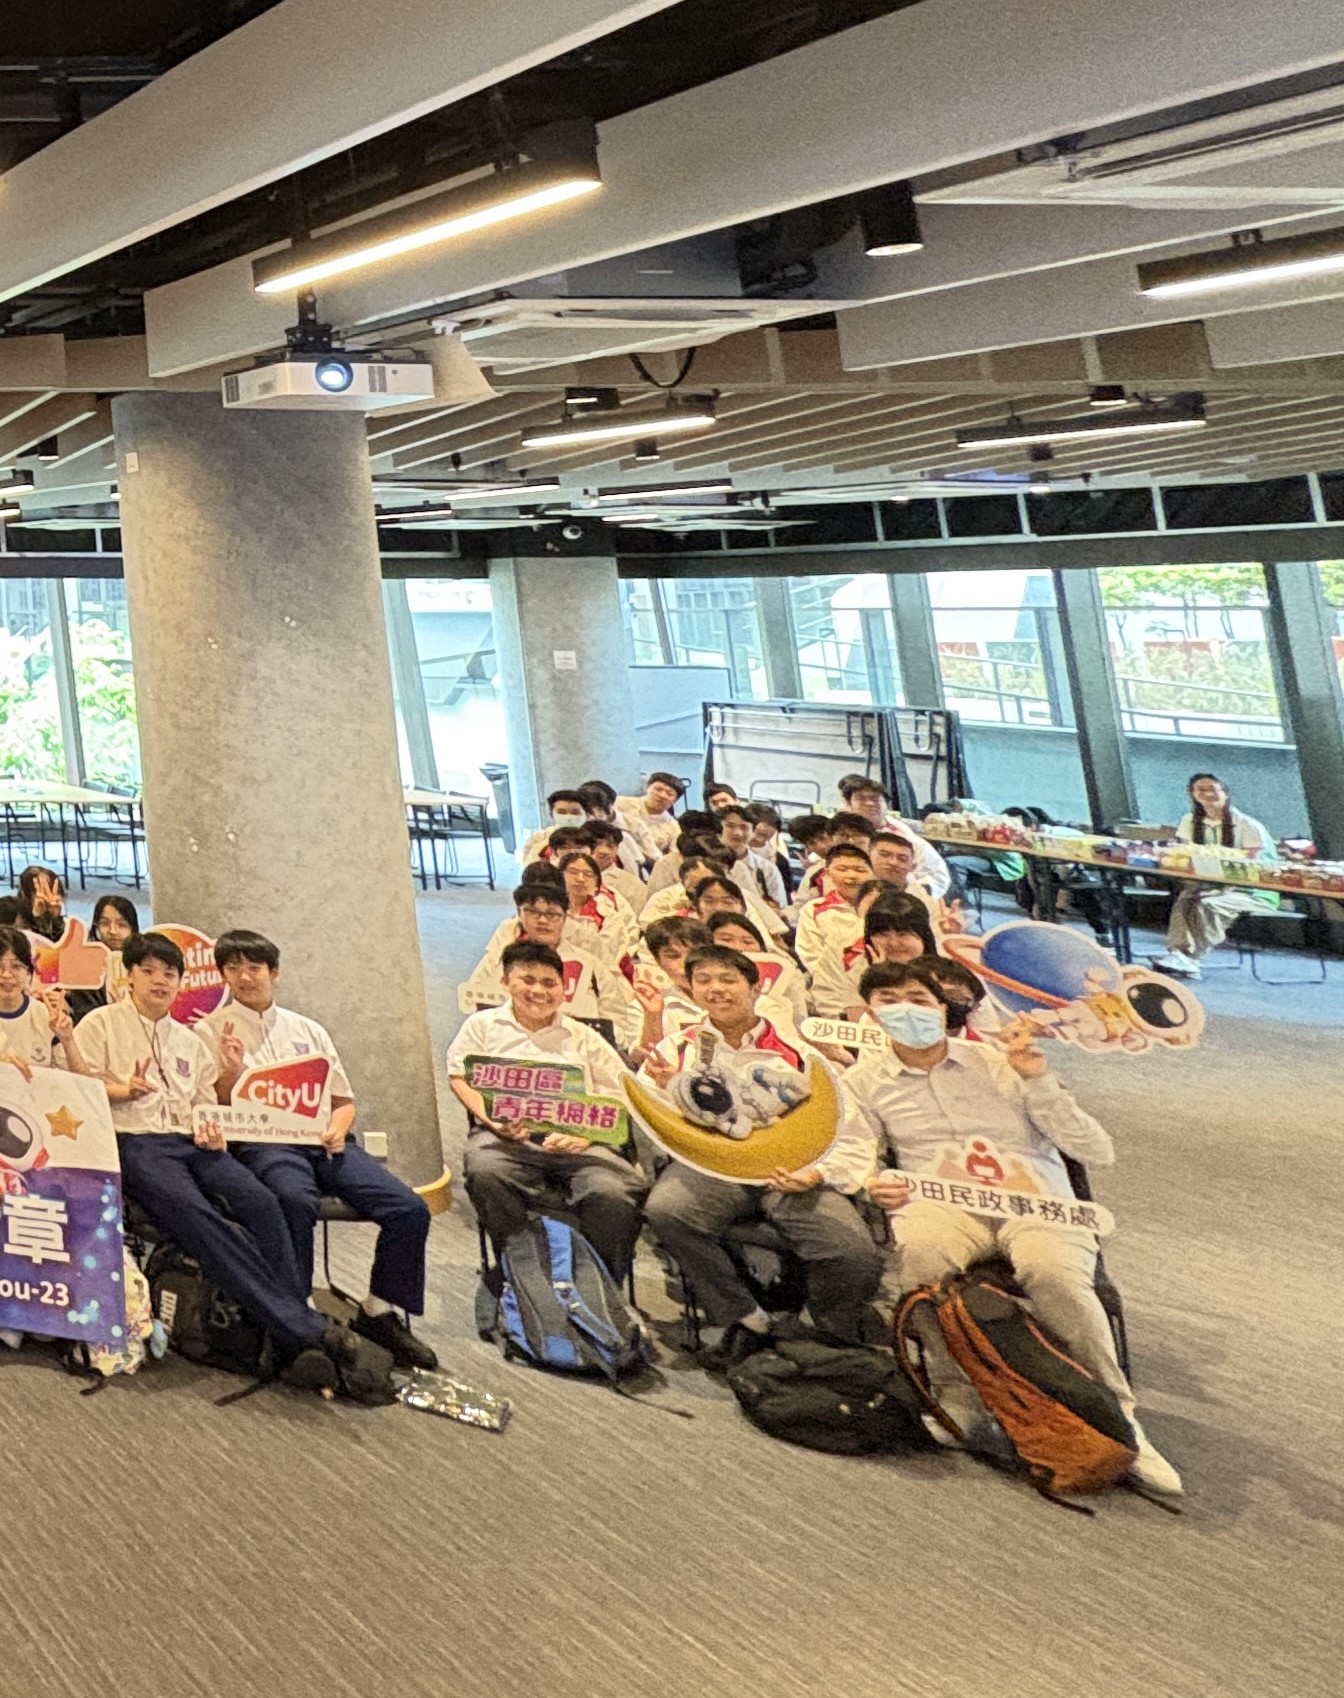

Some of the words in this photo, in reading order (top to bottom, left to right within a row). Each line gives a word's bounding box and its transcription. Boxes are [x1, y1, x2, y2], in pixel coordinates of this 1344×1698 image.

[812, 1020, 890, 1047] 沙田民
[472, 1063, 564, 1092] 沙田區
[248, 1079, 321, 1113] CityU
[492, 1097, 619, 1129] 青年網絡
